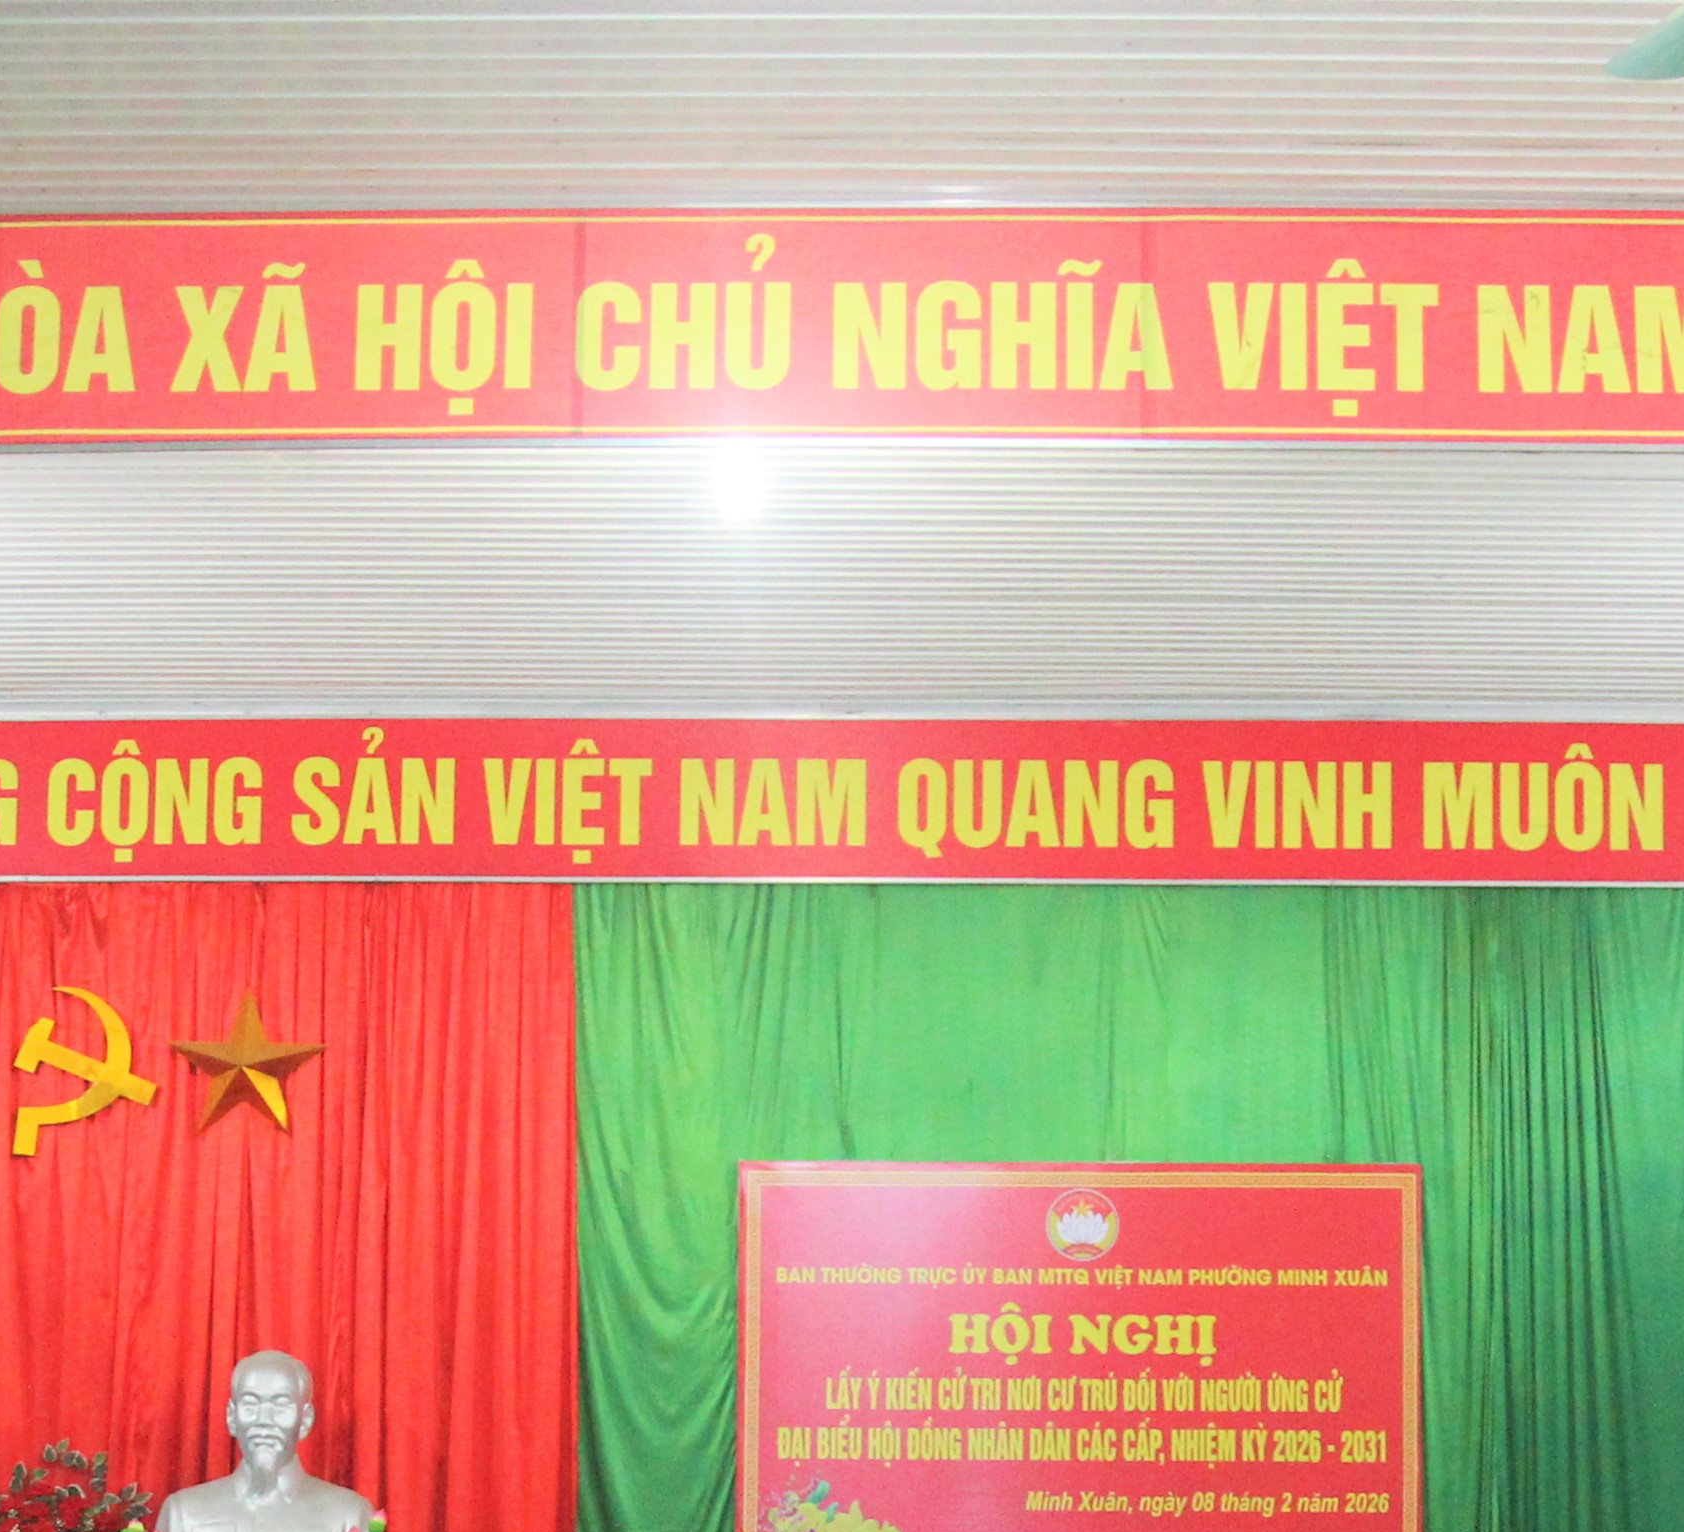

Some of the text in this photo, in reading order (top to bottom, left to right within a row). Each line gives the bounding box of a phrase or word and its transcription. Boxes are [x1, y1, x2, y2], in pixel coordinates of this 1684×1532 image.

[170, 261, 316, 393] XÃ
[354, 258, 534, 416] HỘI
[576, 233, 791, 390] CHỦ
[832, 259, 1173, 390] NGHĨA
[1207, 258, 1439, 417] VIỆT
[46, 741, 263, 863] CỘNG
[291, 727, 455, 847] SẢN
[484, 741, 654, 864] VIỆT
[679, 758, 867, 848] NAM
[896, 756, 1175, 859] QUANG
[1202, 760, 1392, 851] VINH
[1422, 745, 1664, 852] MUÔN
[776, 1261, 1389, 1291] BAN THƯỜNG TRỰC ỦY BAN MTTQ VIỆT NAM PHƯỜNG MINH XUÂN
[948, 1301, 1217, 1367] HỘI NGHỊ
[825, 1365, 1344, 1413] LẤY Ý KIẾN CỬ TRI NƠI CƯ TRÚ ĐỐI VỚI NGƯỜI ỨNG CỬ
[777, 1427, 812, 1467] ĐẠI
[817, 1413, 863, 1460] BIỂU
[868, 1420, 901, 1467] HỘI
[968, 1421, 1024, 1461] NHÂN
[1029, 1421, 1071, 1461] DÂN
[1077, 1421, 1117, 1462] CÁC
[1122, 1417, 1165, 1465] CẤP,
[1171, 1422, 1236, 1469] NHIỆM
[1242, 1422, 1267, 1462] KỲ
[1273, 1430, 1322, 1463] 2026
[1340, 1430, 1387, 1463] 2031
[1026, 1491, 1390, 1518] Minh Xuân, ngày 08 tháng 2 năm 2026
